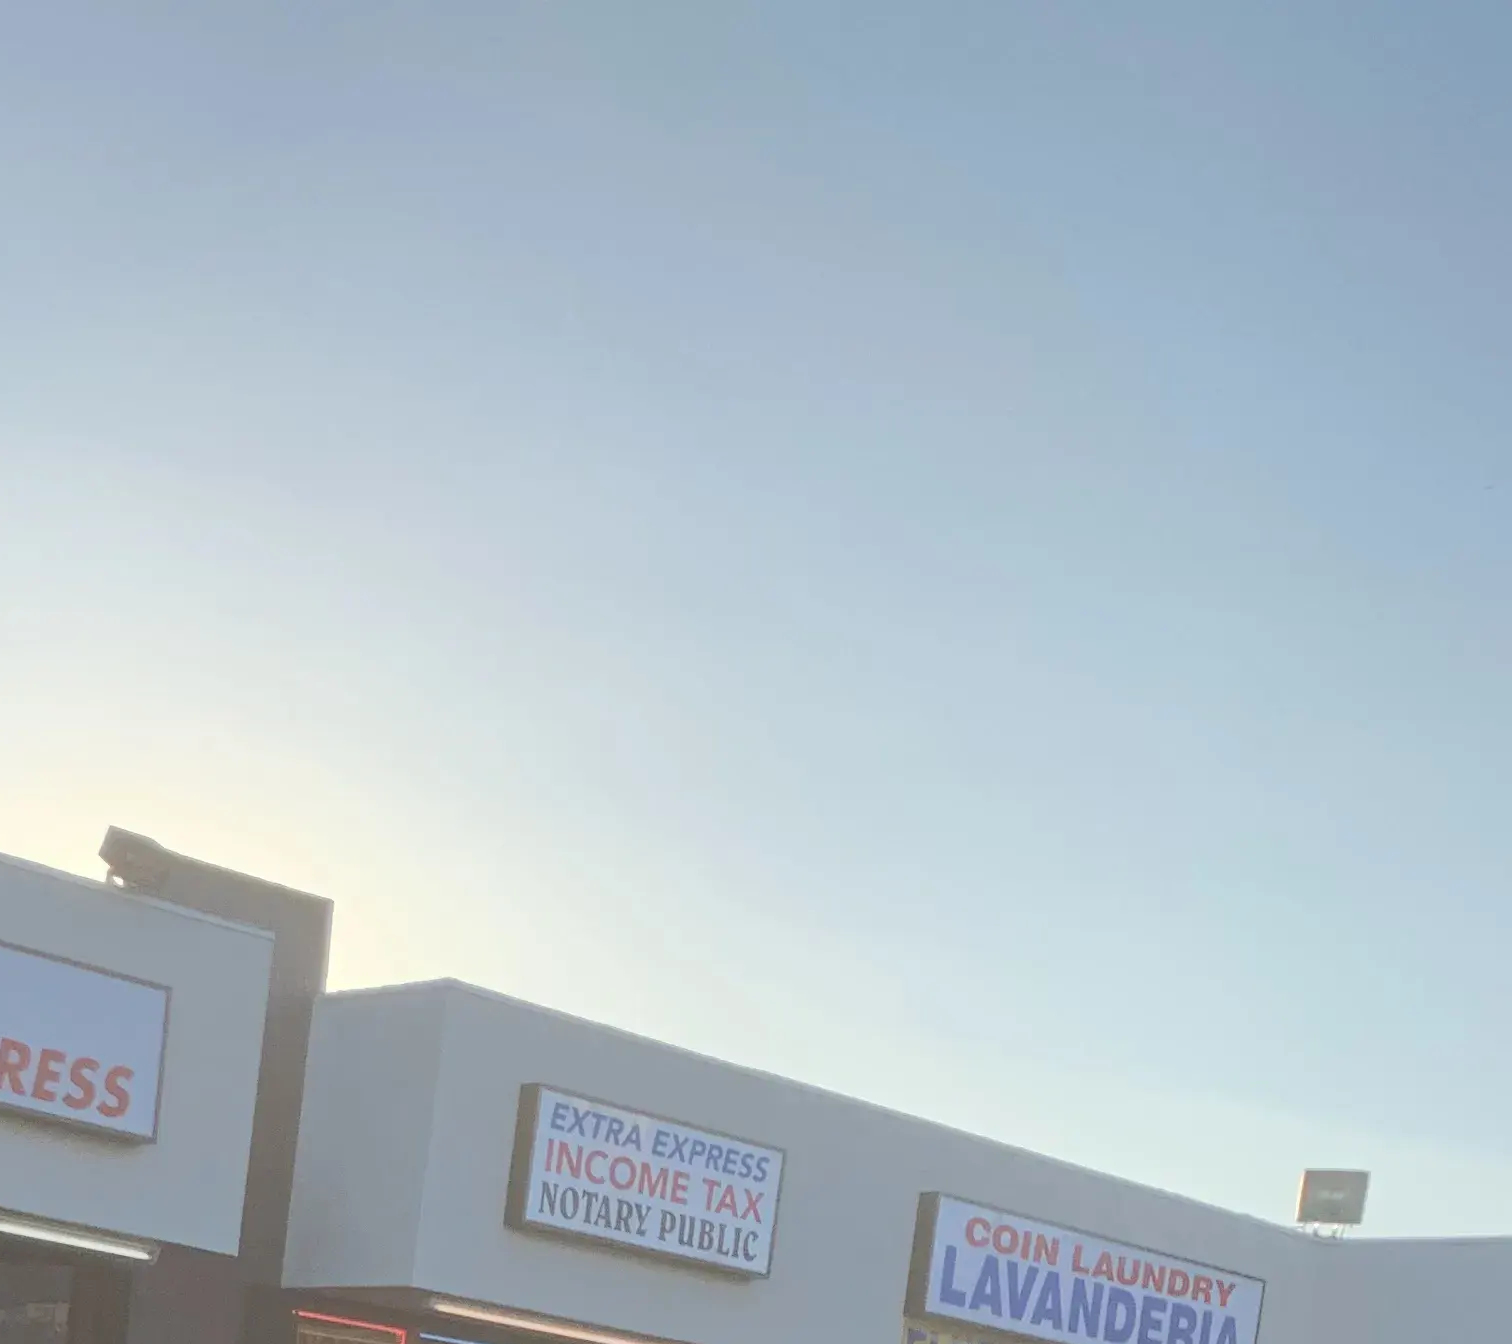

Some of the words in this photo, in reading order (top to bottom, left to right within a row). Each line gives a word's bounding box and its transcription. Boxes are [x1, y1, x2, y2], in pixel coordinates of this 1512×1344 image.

[544, 1137, 691, 1207] INCOME
[701, 1176, 765, 1225] TAX
[549, 1101, 642, 1153] EXTRA
[651, 1128, 771, 1183] EXPRESS
[538, 1180, 653, 1238] NOTARY
[657, 1208, 760, 1262] PUBLIC
[964, 1216, 1060, 1267] COIN
[1071, 1243, 1237, 1308] LAUNDRY
